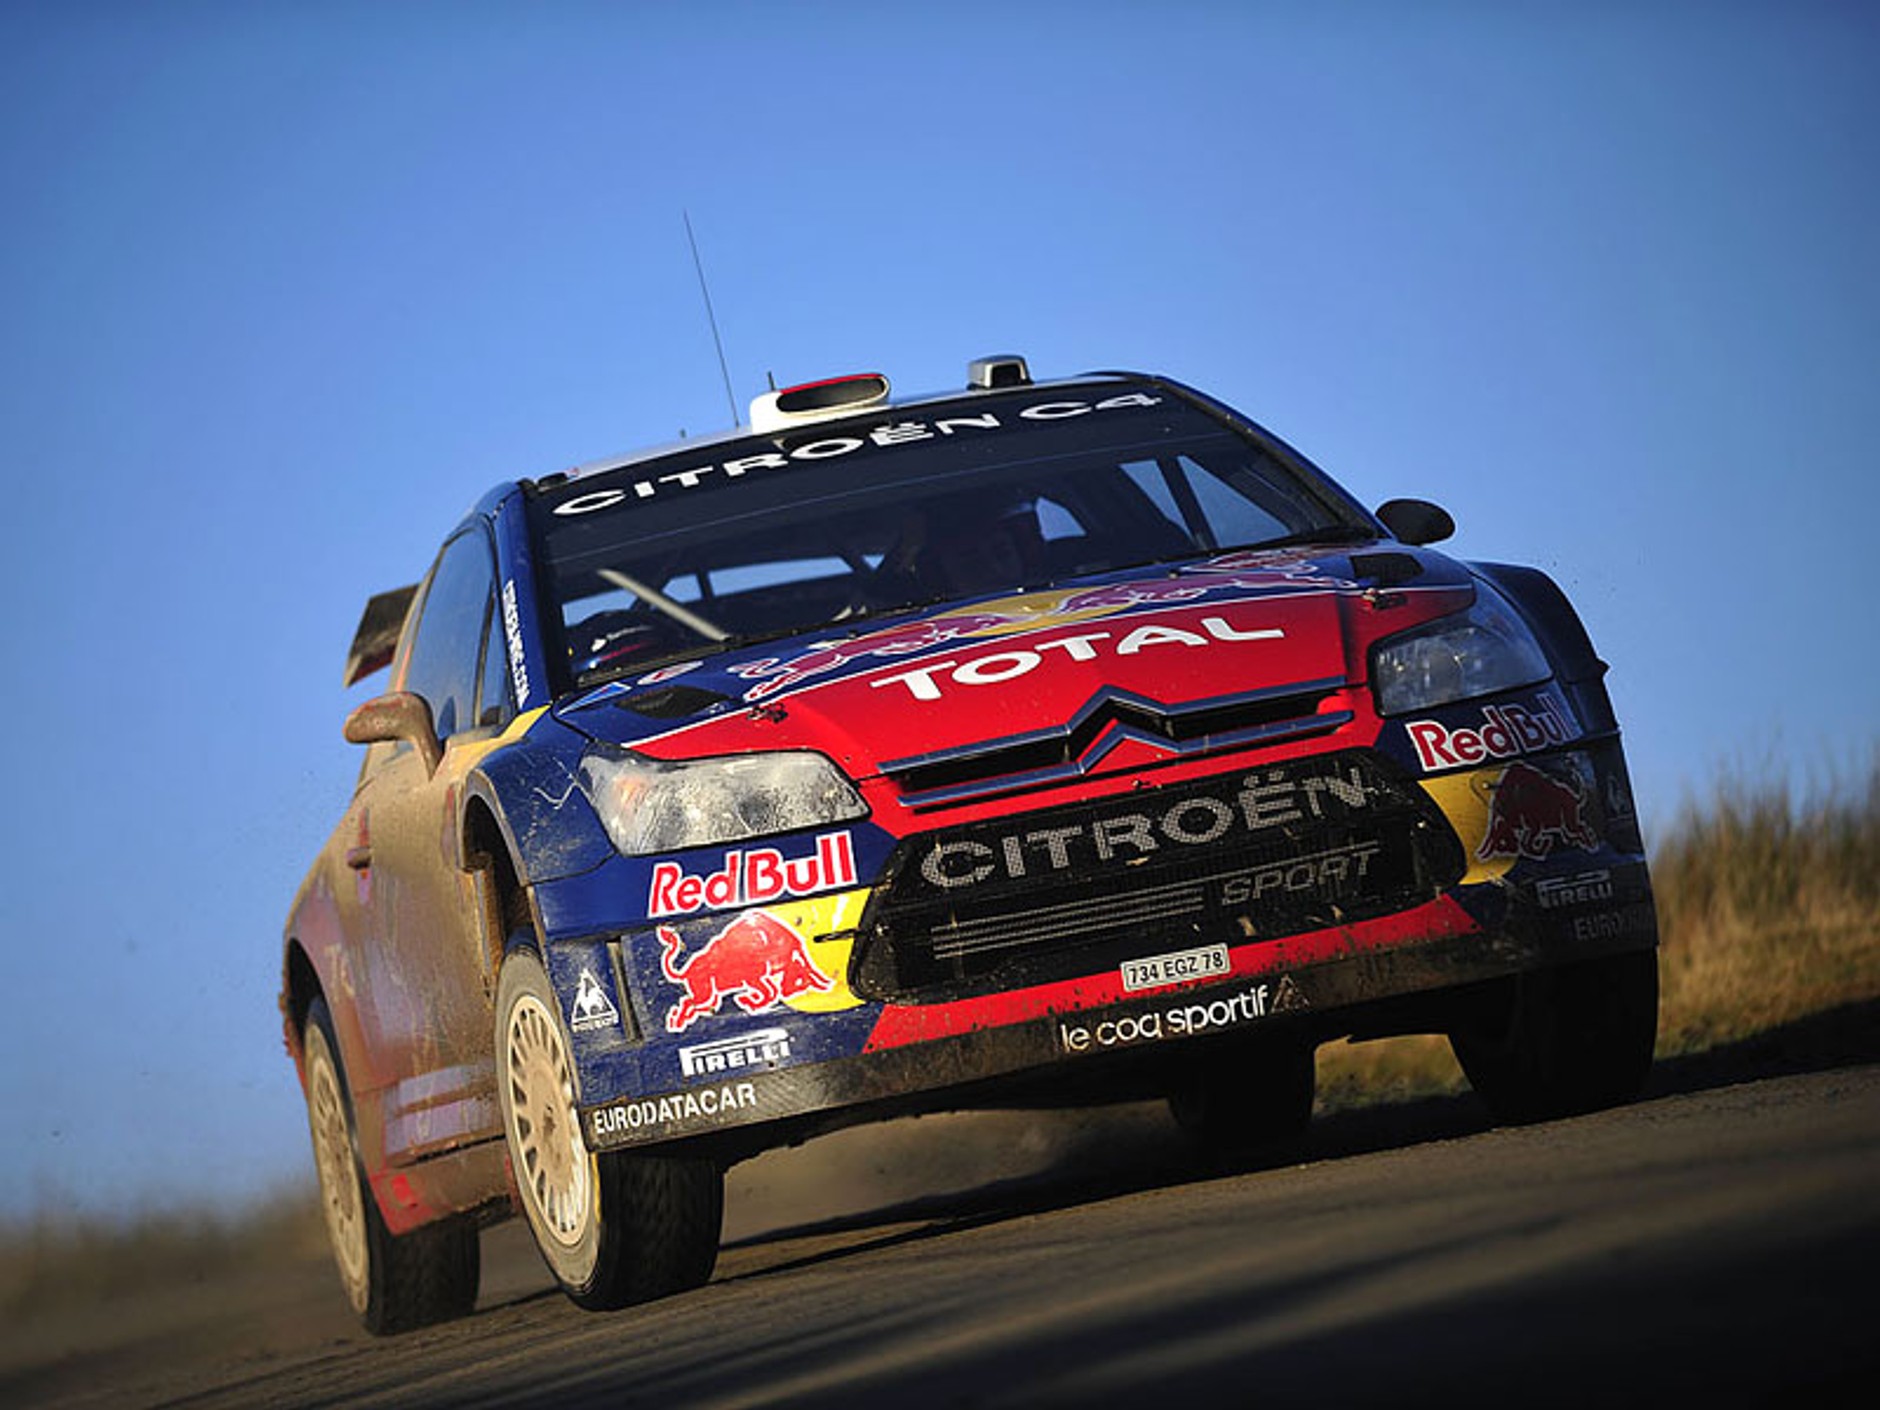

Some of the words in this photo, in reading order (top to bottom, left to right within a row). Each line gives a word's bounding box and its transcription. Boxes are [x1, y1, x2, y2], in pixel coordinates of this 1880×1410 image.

[553, 413, 1001, 516] CITROËN
[1019, 392, 1164, 421] C4
[870, 615, 1284, 701] TOTAL
[1406, 705, 1519, 771] Red
[921, 767, 1368, 888] CITROËN
[649, 850, 737, 917] Red
[745, 832, 856, 900] Bull
[1221, 848, 1381, 905] SPORT
[1536, 869, 1613, 908] PIRELLI
[1128, 964, 1160, 985] 734
[1163, 957, 1198, 977] EGZ
[1203, 951, 1223, 969] 78
[1061, 1024, 1091, 1051] le
[1167, 985, 1269, 1034] sportif
[679, 1028, 795, 1077] PIRELLI
[594, 1083, 757, 1134] EURODATACAR
